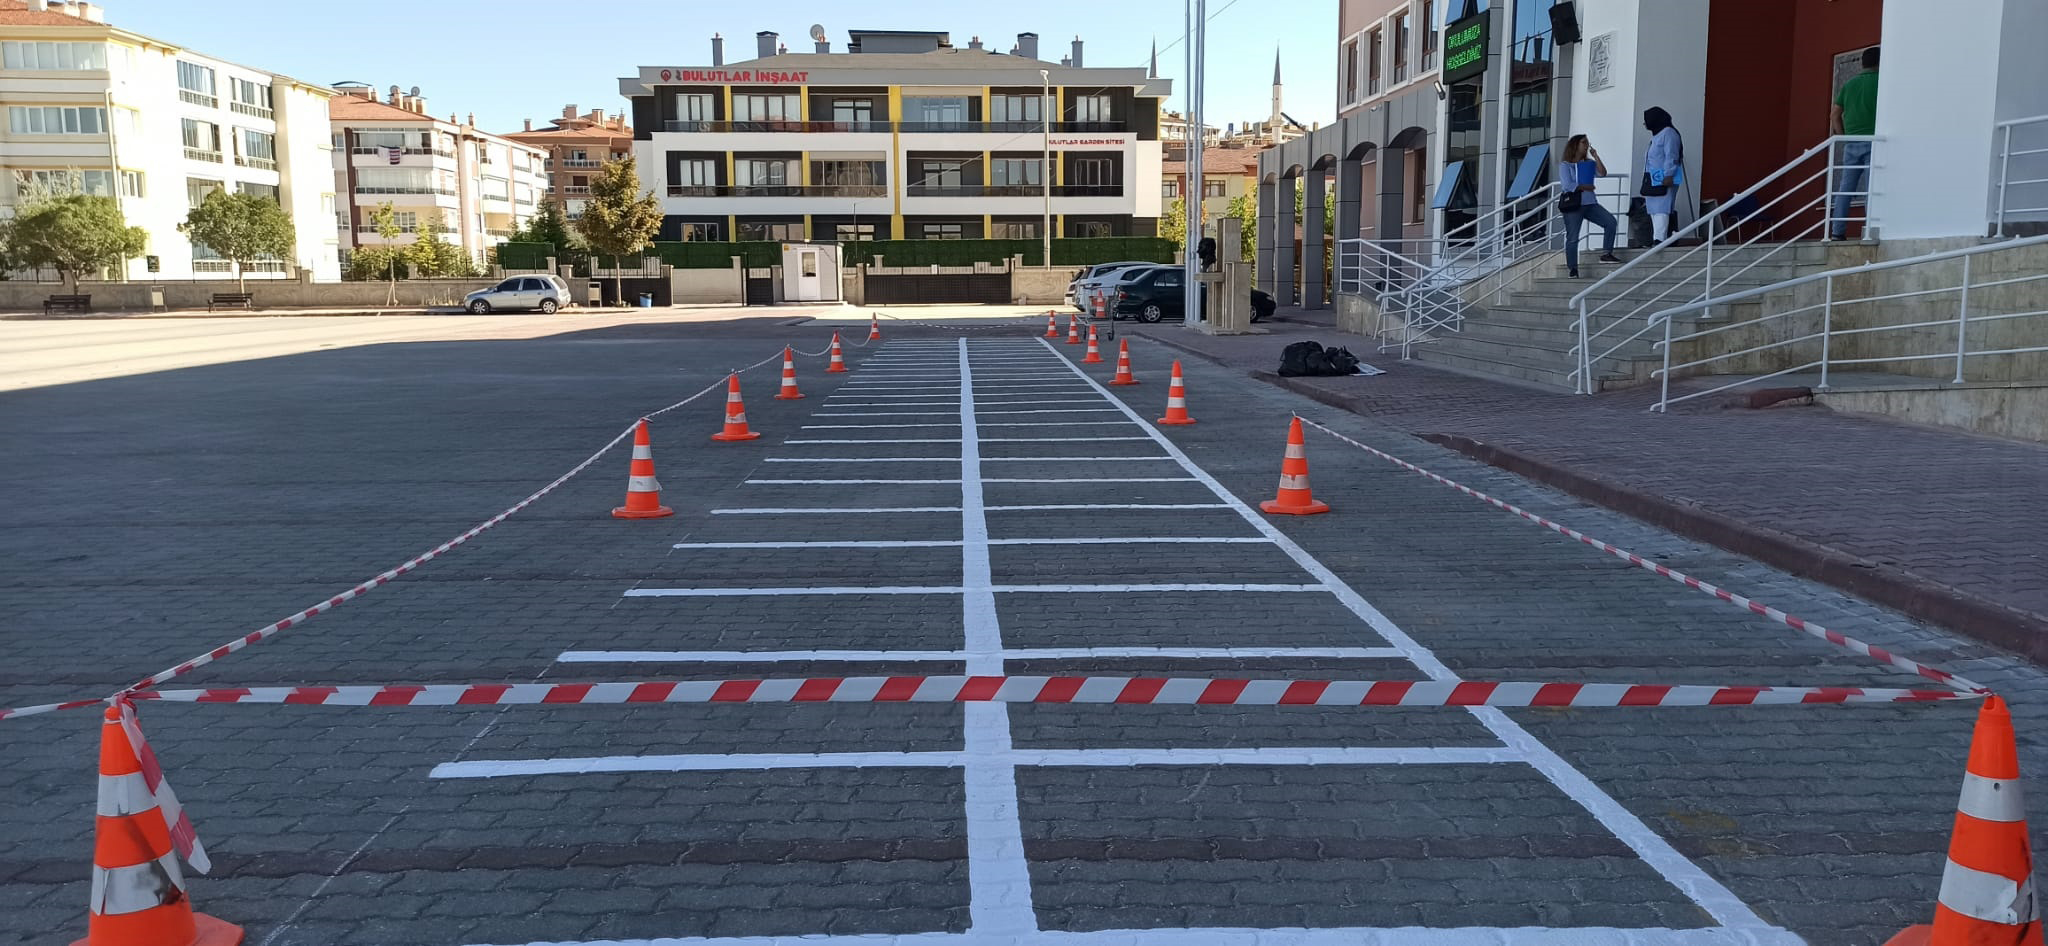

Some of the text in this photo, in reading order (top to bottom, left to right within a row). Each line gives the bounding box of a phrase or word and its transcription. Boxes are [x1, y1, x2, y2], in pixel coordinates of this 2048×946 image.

[1448, 23, 1481, 49] OKULUMUZA
[682, 69, 809, 84] BULUTLAR İNŞAAT
